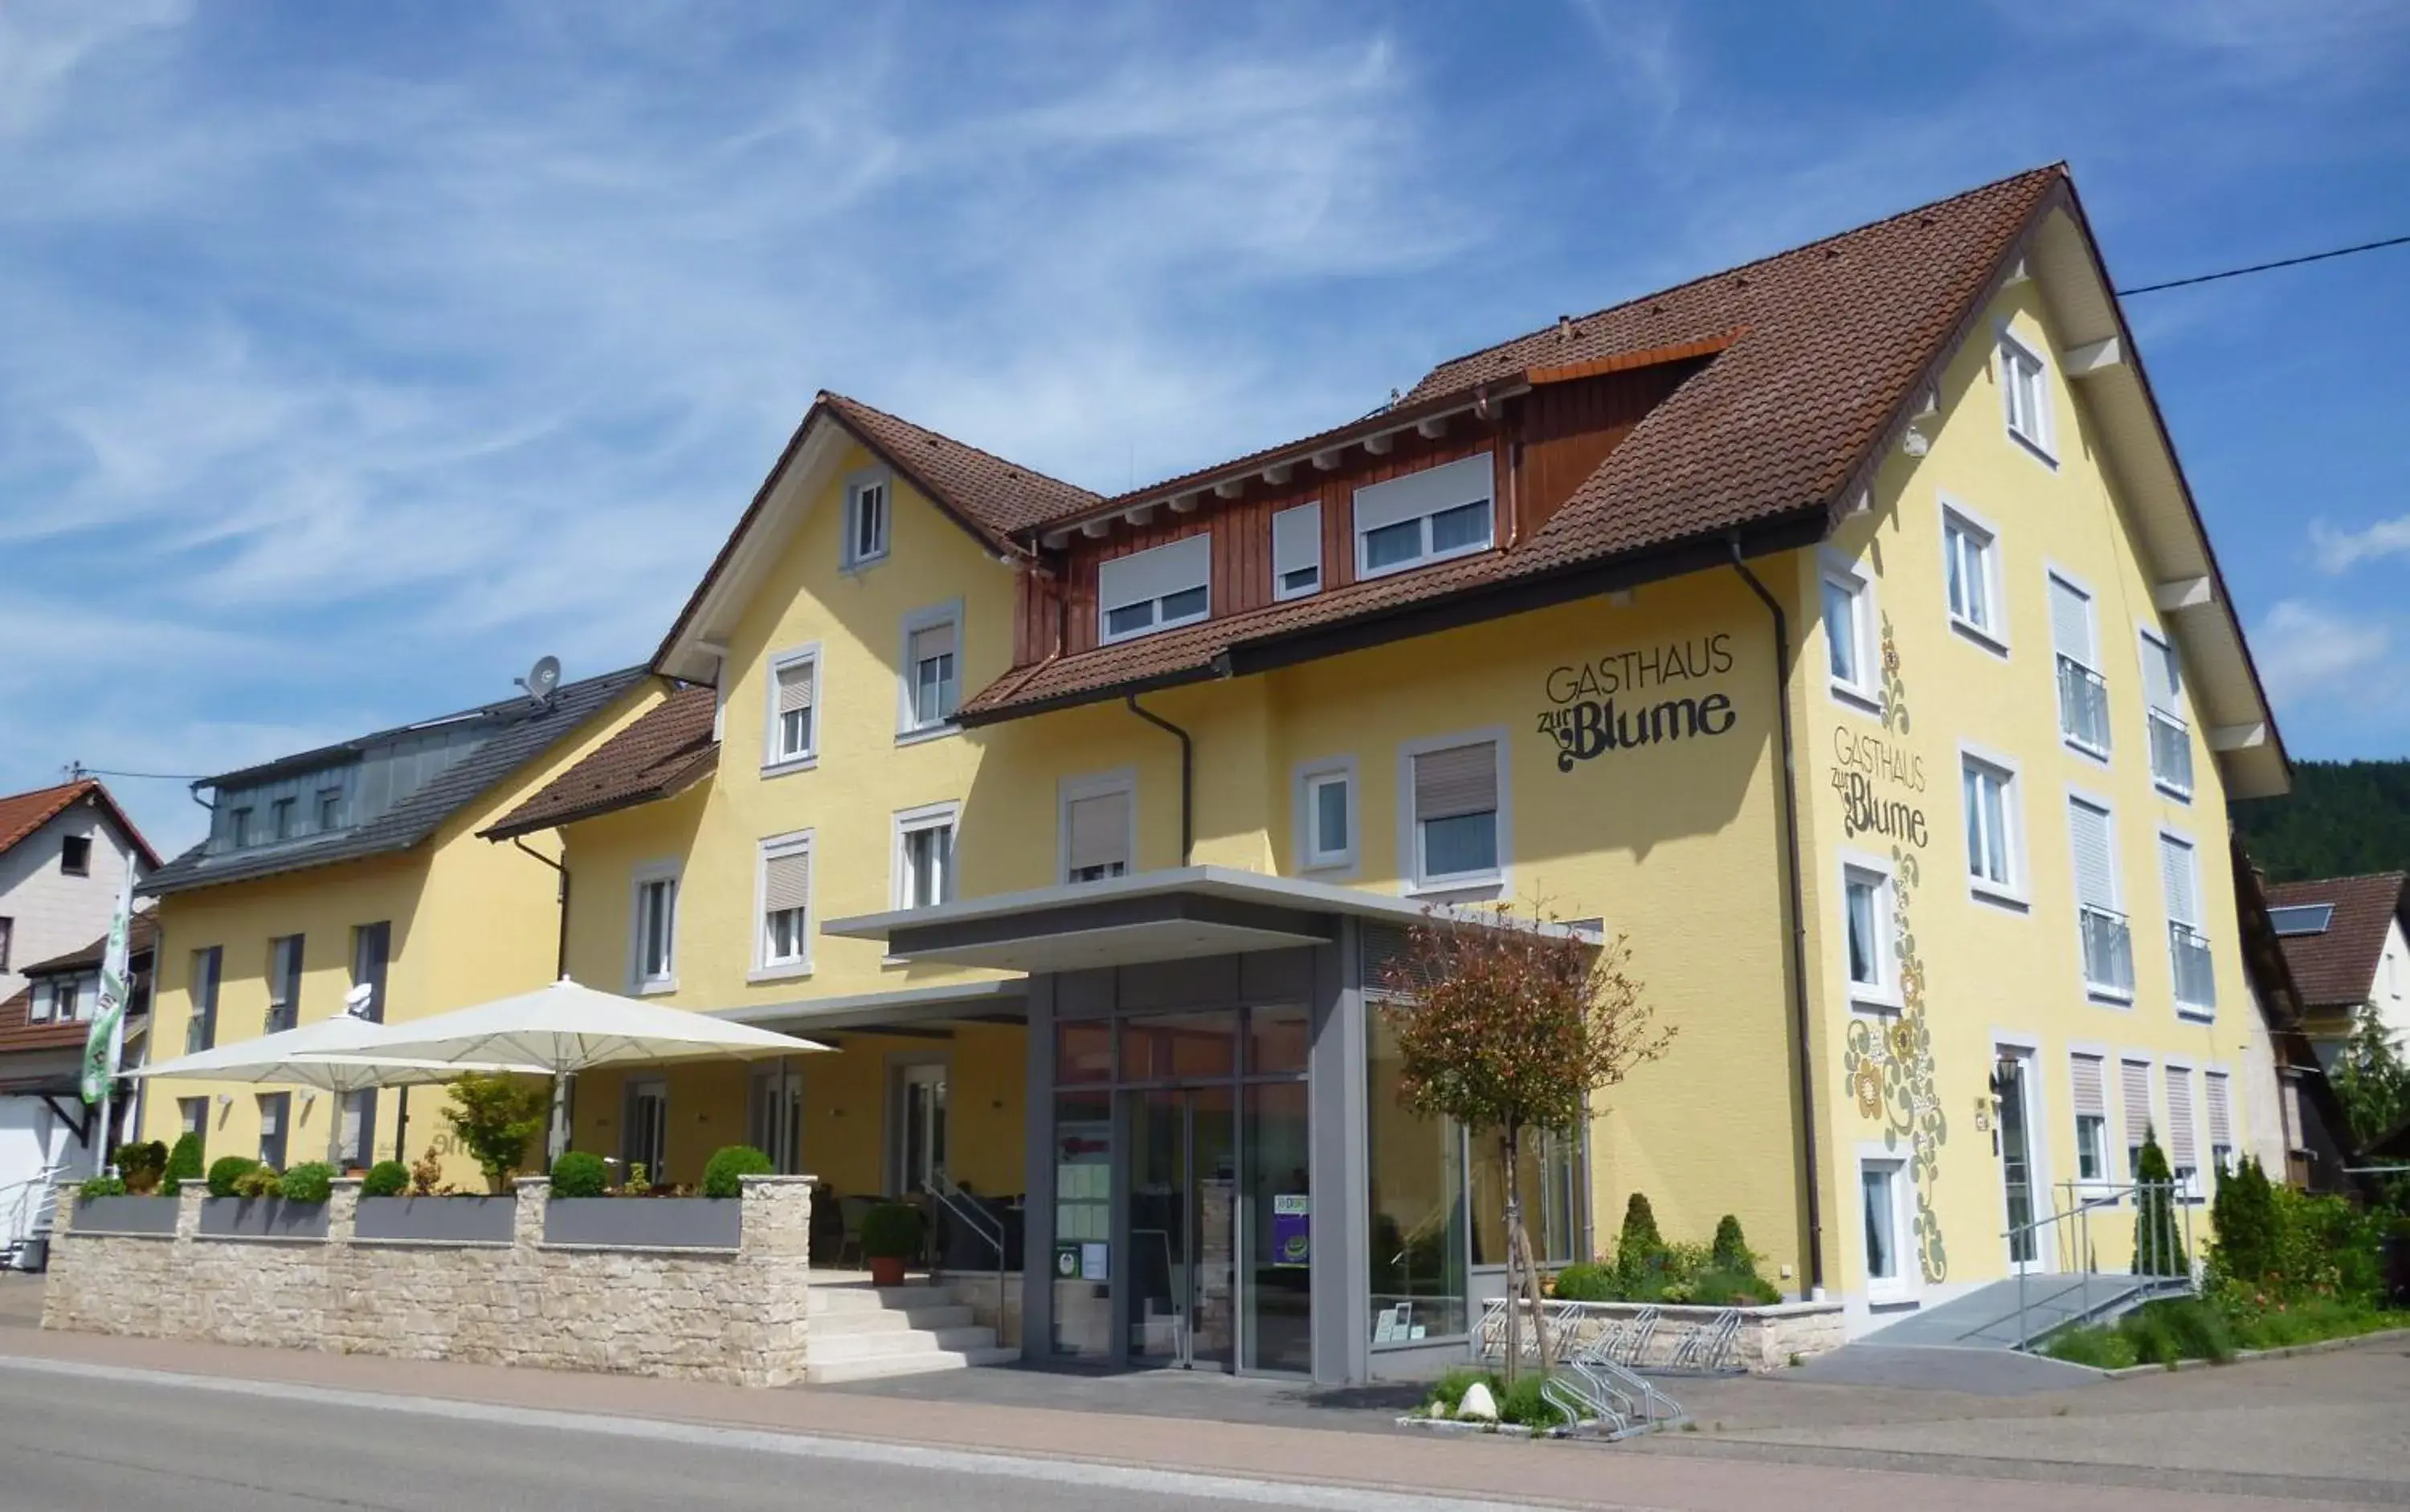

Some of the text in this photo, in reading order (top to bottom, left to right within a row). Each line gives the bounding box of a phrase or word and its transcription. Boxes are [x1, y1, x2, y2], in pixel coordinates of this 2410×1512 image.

[1546, 633, 1733, 704] GASTHAUS
[1536, 693, 1737, 773] zur Blume
[1834, 725, 1926, 793] GASTHAUS
[1831, 766, 1928, 848] zur Blume
